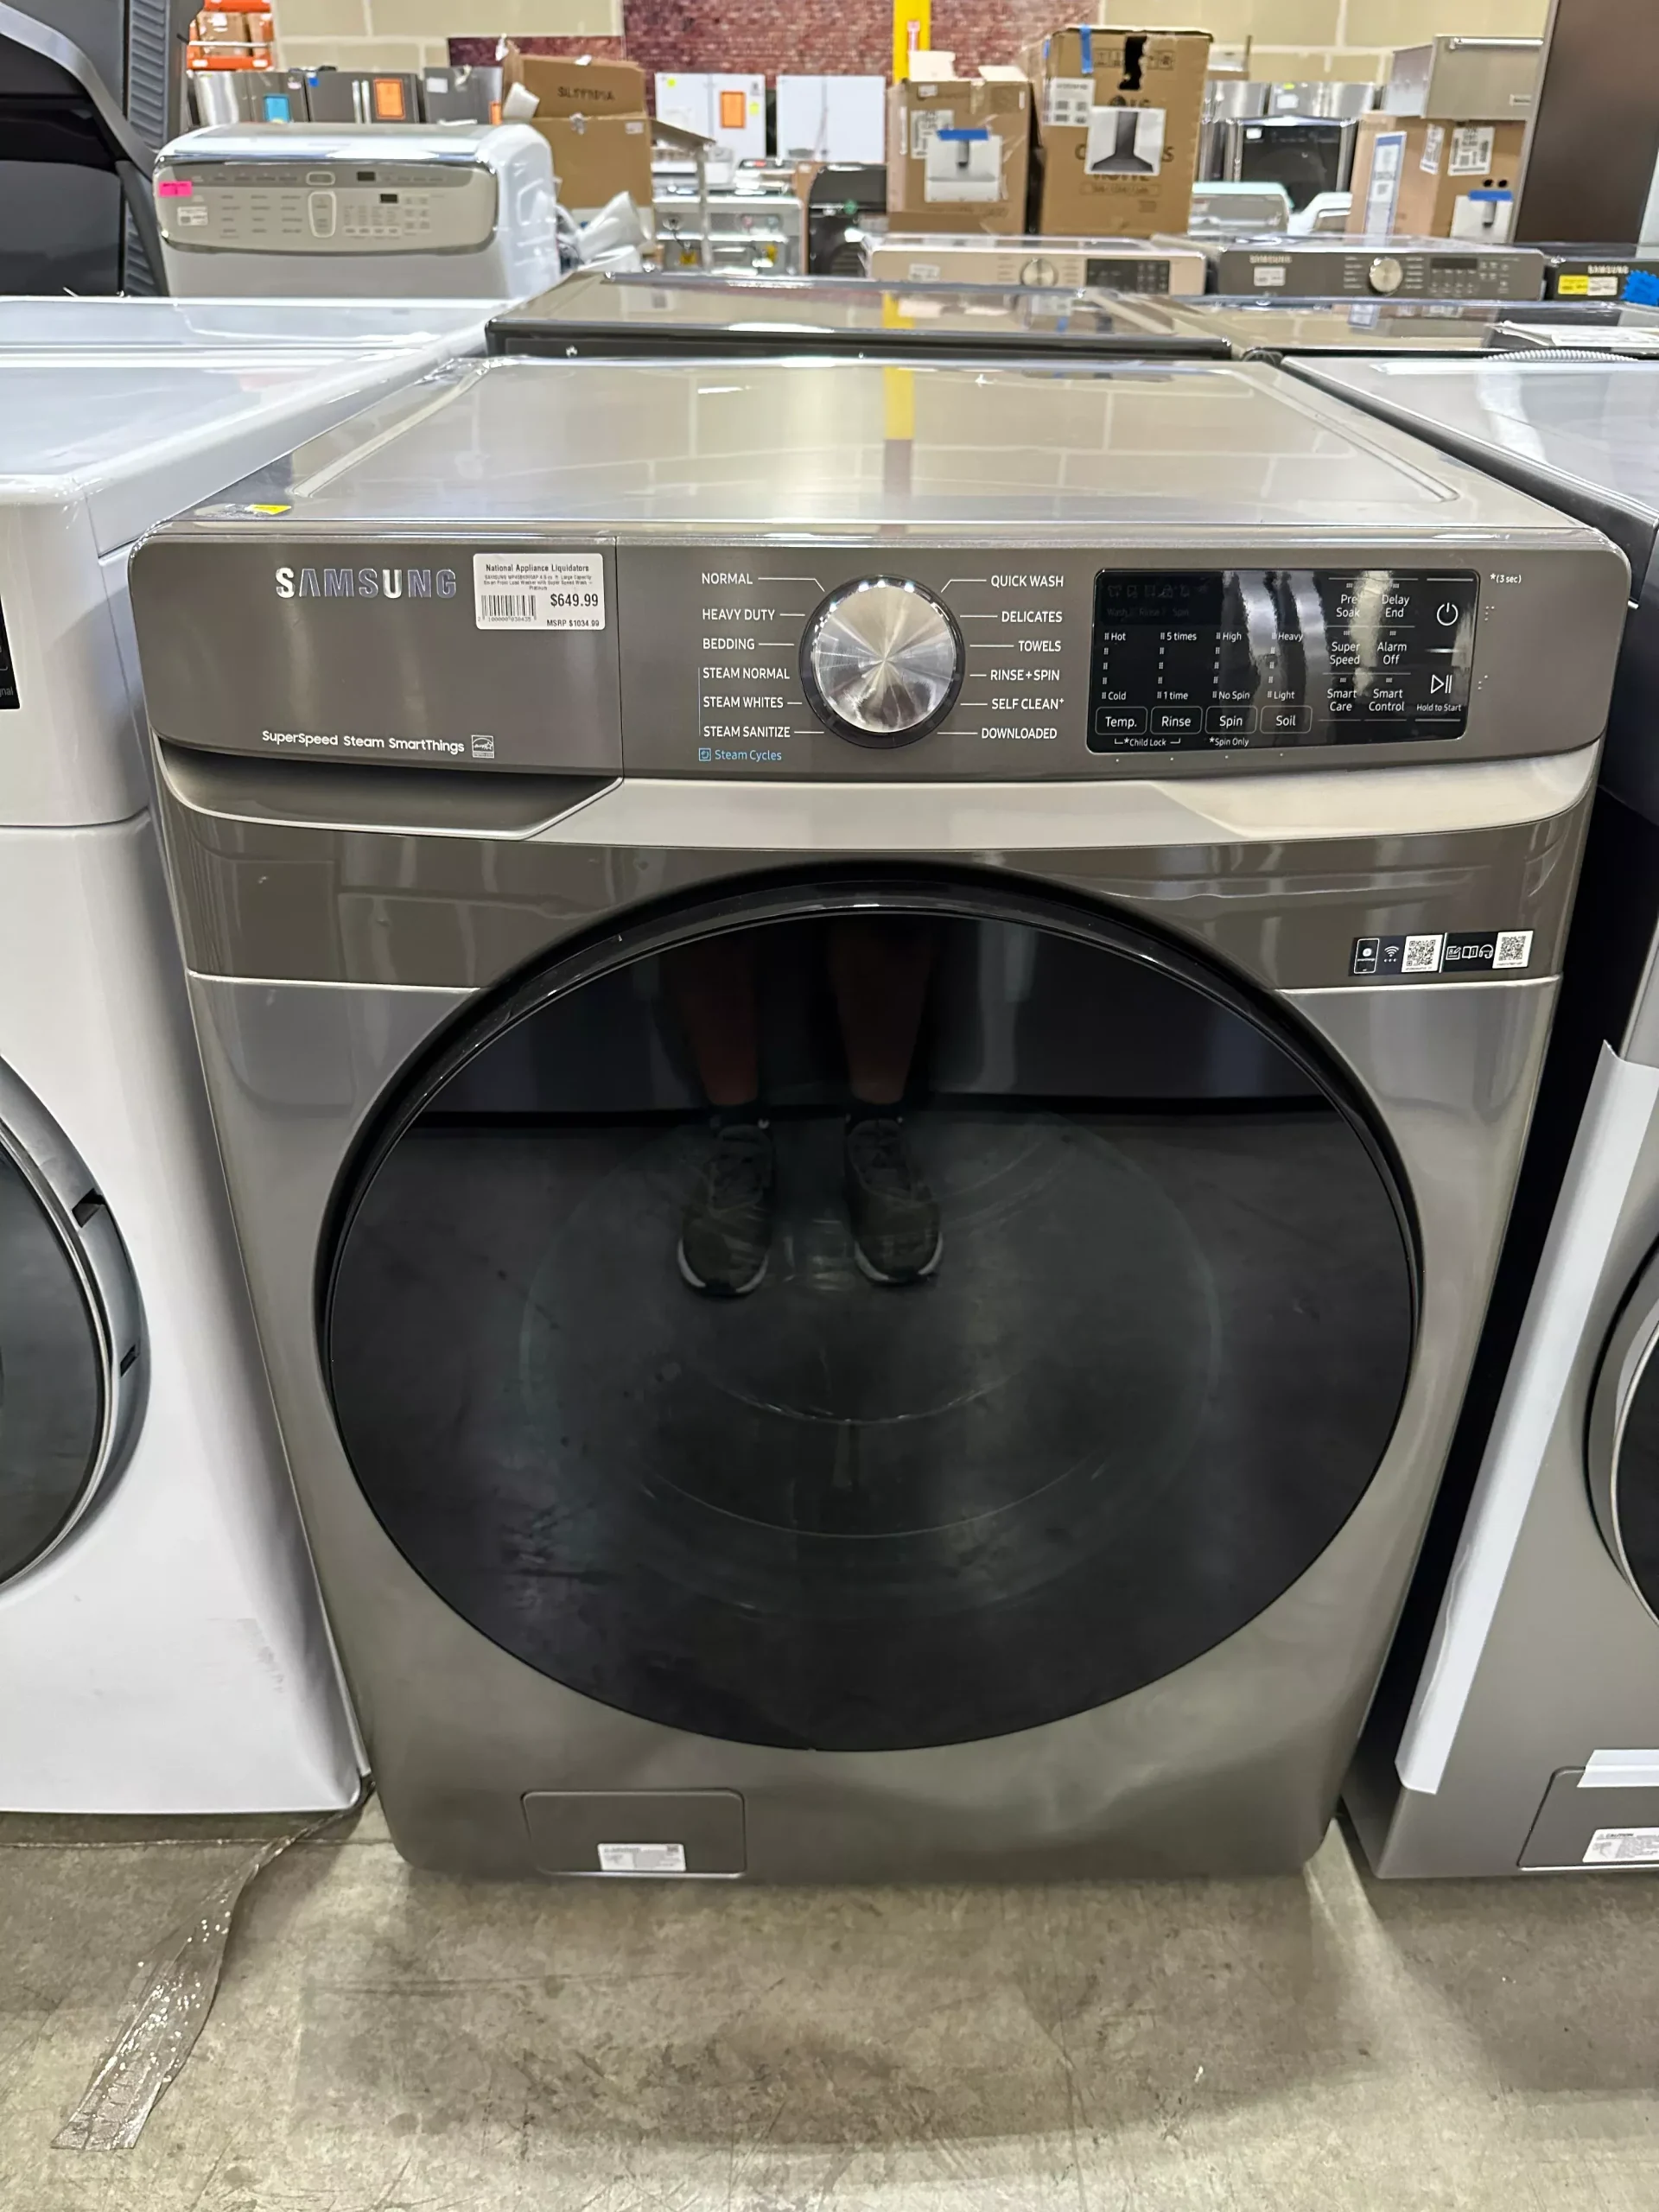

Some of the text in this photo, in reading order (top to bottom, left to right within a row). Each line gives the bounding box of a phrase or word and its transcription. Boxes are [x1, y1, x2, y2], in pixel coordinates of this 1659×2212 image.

[516, 564, 549, 574] Appliance
[551, 564, 589, 574] Liquidators
[275, 567, 457, 599] SAMSUNG
[702, 573, 753, 584] NORMAL
[991, 575, 1064, 588] QUICK WASH
[1506, 575, 1522, 583] sec)
[550, 594, 599, 607] $649.99
[1341, 594, 1358, 604] Pre
[1382, 594, 1409, 607] Delay
[702, 608, 775, 620] HEAVY DUTY
[1001, 611, 1063, 623] DELICATES
[1172, 607, 1189, 618] Spin
[1336, 608, 1360, 618] Soak
[1385, 608, 1404, 618] End
[1110, 632, 1126, 641] Hot
[1166, 632, 1197, 641] 5 times
[1223, 632, 1242, 642] High
[1278, 632, 1303, 642] Heavy
[702, 639, 755, 650] BEDDING
[1018, 640, 1061, 652] TOWELS
[1332, 642, 1360, 653] Super
[1377, 642, 1407, 652] Alarm
[1330, 655, 1360, 666] Speed
[1382, 655, 1400, 664] Off
[702, 667, 790, 679] STEAM NORMAL
[1108, 691, 1127, 701] Cold
[1163, 691, 1189, 700] 1 time
[1218, 691, 1250, 702] No Spin
[1274, 690, 1295, 702] Light
[1327, 689, 1357, 698] Smart
[1373, 689, 1403, 698] Smart
[703, 696, 784, 708] STEAM WHITES
[992, 698, 1019, 709] SELF
[1330, 702, 1352, 712] Care
[1369, 702, 1405, 712] Control
[1417, 703, 1433, 712] Hold
[1105, 716, 1137, 729] Temp.
[1161, 715, 1192, 727] Rinse
[1219, 715, 1243, 728] Spin
[1275, 715, 1296, 726] Soil
[703, 726, 791, 738] STEAM SANITIZE
[982, 728, 1058, 740] DOWNLOADED
[263, 730, 465, 755] SuperSpeed Steam SmartThings
[1150, 738, 1166, 747] Lock
[1232, 738, 1249, 747] Only
[715, 749, 782, 762] Steam Cycles
